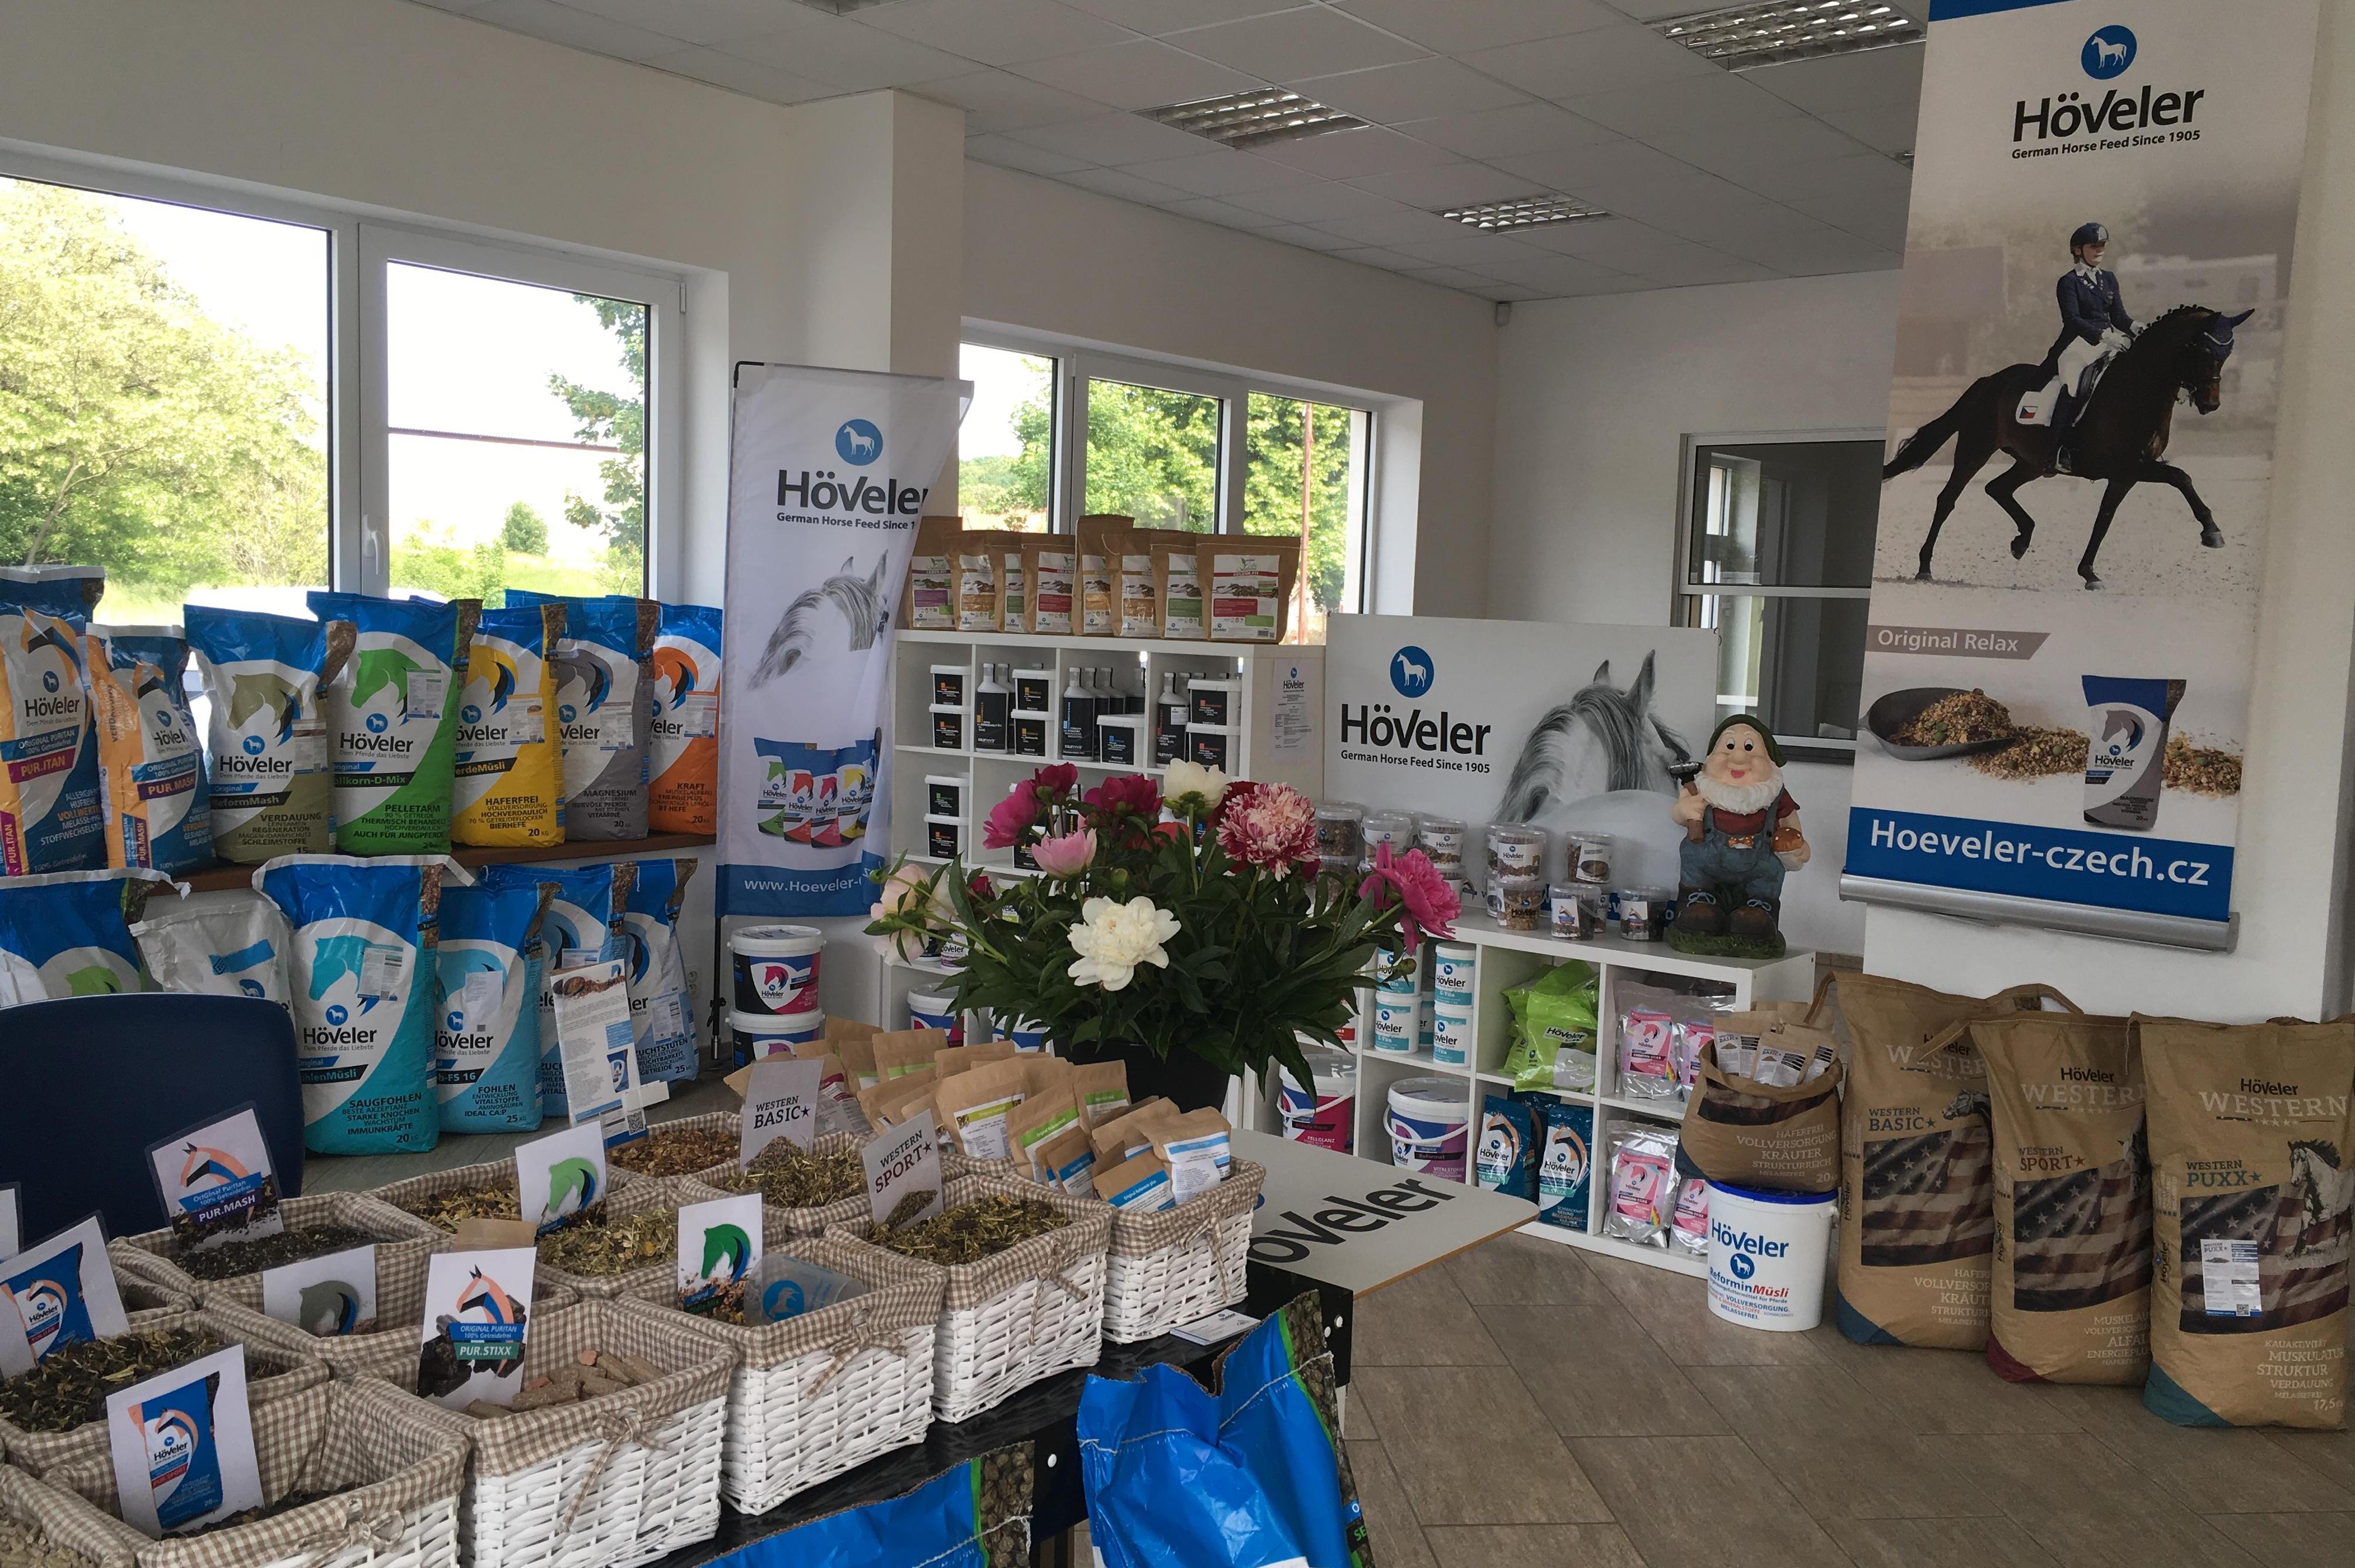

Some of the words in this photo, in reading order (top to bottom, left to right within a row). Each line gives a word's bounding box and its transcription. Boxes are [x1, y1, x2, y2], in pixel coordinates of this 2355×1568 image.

[2012, 85, 2205, 142] Höveler
[2012, 144, 2059, 160] German
[2061, 140, 2097, 155] Horse
[2099, 137, 2130, 151] Feed
[2132, 133, 2165, 147] Since
[2168, 129, 2200, 143] 1905
[777, 512, 820, 525] German
[822, 515, 853, 527] Horse
[855, 518, 880, 529] Feed
[883, 520, 908, 530] Since
[1878, 629, 1958, 653] Original
[1965, 634, 2019, 652] Relax
[1283, 680, 1305, 689] Höveler
[24, 697, 81, 717] Höveler
[1341, 703, 1491, 755] Höveler
[18, 736, 51, 749] ORIGINAL
[340, 733, 413, 753] Höveler
[21, 755, 66, 777] PUR.ITAN
[220, 756, 293, 773] Höveler
[1341, 749, 1378, 763] German
[1380, 753, 1408, 765] Horse
[1410, 756, 1434, 767] Feed
[1436, 759, 1462, 770] Since
[1465, 761, 1491, 773] 1905
[2095, 755, 2135, 766] Höveler
[148, 776, 195, 795] PUR.MASH
[486, 796, 539, 805] HAFERFREI
[487, 802, 548, 810] VOLLVERSORGUNG
[385, 804, 440, 813] PELLETARM
[480, 809, 548, 817] HOCHVERDAULICH
[260, 813, 321, 822] VERDAUUNG
[486, 815, 543, 823] GETREIDEFLOCKEN
[489, 822, 526, 830] BIERHEFE
[380, 830, 395, 839] FÜR
[8, 823, 16, 863] PUR.ITAN
[1870, 819, 2211, 886] Hoeveler-czech.cz
[1436, 974, 1466, 988] Höveler
[1375, 1021, 1402, 1033] Höveler
[1546, 1027, 1586, 1039] Höveler
[304, 1027, 377, 1045] Höveler
[462, 1072, 476, 1081] 16
[675, 1066, 686, 1074] 25
[2061, 1067, 2114, 1083] Höveler
[478, 1084, 516, 1093] FOHLEN
[2240, 1078, 2298, 1096] Höveler
[349, 1092, 422, 1108] SAUGFOHLEN
[475, 1096, 520, 1105] VITALSTOFFE
[756, 1095, 799, 1112] WESTERN
[2199, 1091, 2347, 1117] WESTERN
[347, 1112, 378, 1121] STARKE
[380, 1107, 420, 1119] KNOCHEN
[366, 1103, 407, 1113] AKZEPTANZ
[1868, 1107, 1921, 1117] WESTERN
[364, 1117, 406, 1127] WACHSTUM
[506, 1115, 518, 1123] 25
[754, 1105, 801, 1129] BASIC
[1776, 1124, 1824, 1138] HAFERFREI
[1868, 1117, 1925, 1132] BASIC
[396, 1134, 410, 1143] 20
[1737, 1131, 1837, 1148] VOLLVERSORGUNG
[879, 1130, 923, 1168] WESTERN
[1762, 1148, 1822, 1160] KRÄUTER
[875, 1147, 923, 1194] SPORT
[1544, 1160, 1575, 1175] Höveler
[1752, 1158, 1832, 1170] STRUKTURREICH
[2020, 1156, 2073, 1171] SPORT
[2185, 1160, 2243, 1171] WESTERN
[2187, 1171, 2248, 1188] PUXX
[199, 1195, 256, 1222] PUR.MASH
[1711, 1218, 1789, 1258] Höveler
[1710, 1266, 1790, 1297] ReforminMüsli
[1726, 1295, 1790, 1313] VOLLVERSORGUNG.
[29, 1305, 58, 1323] Höveler
[2265, 1338, 2327, 1348] KAUAKTIVITÄT
[459, 1346, 512, 1356] PUR.STIXX
[2256, 1363, 2329, 1376] STRUKTUR
[2270, 1378, 2333, 1389] VERDAUUNG
[2313, 1398, 2335, 1411] 17,5
[154, 1442, 188, 1461] Höveler
